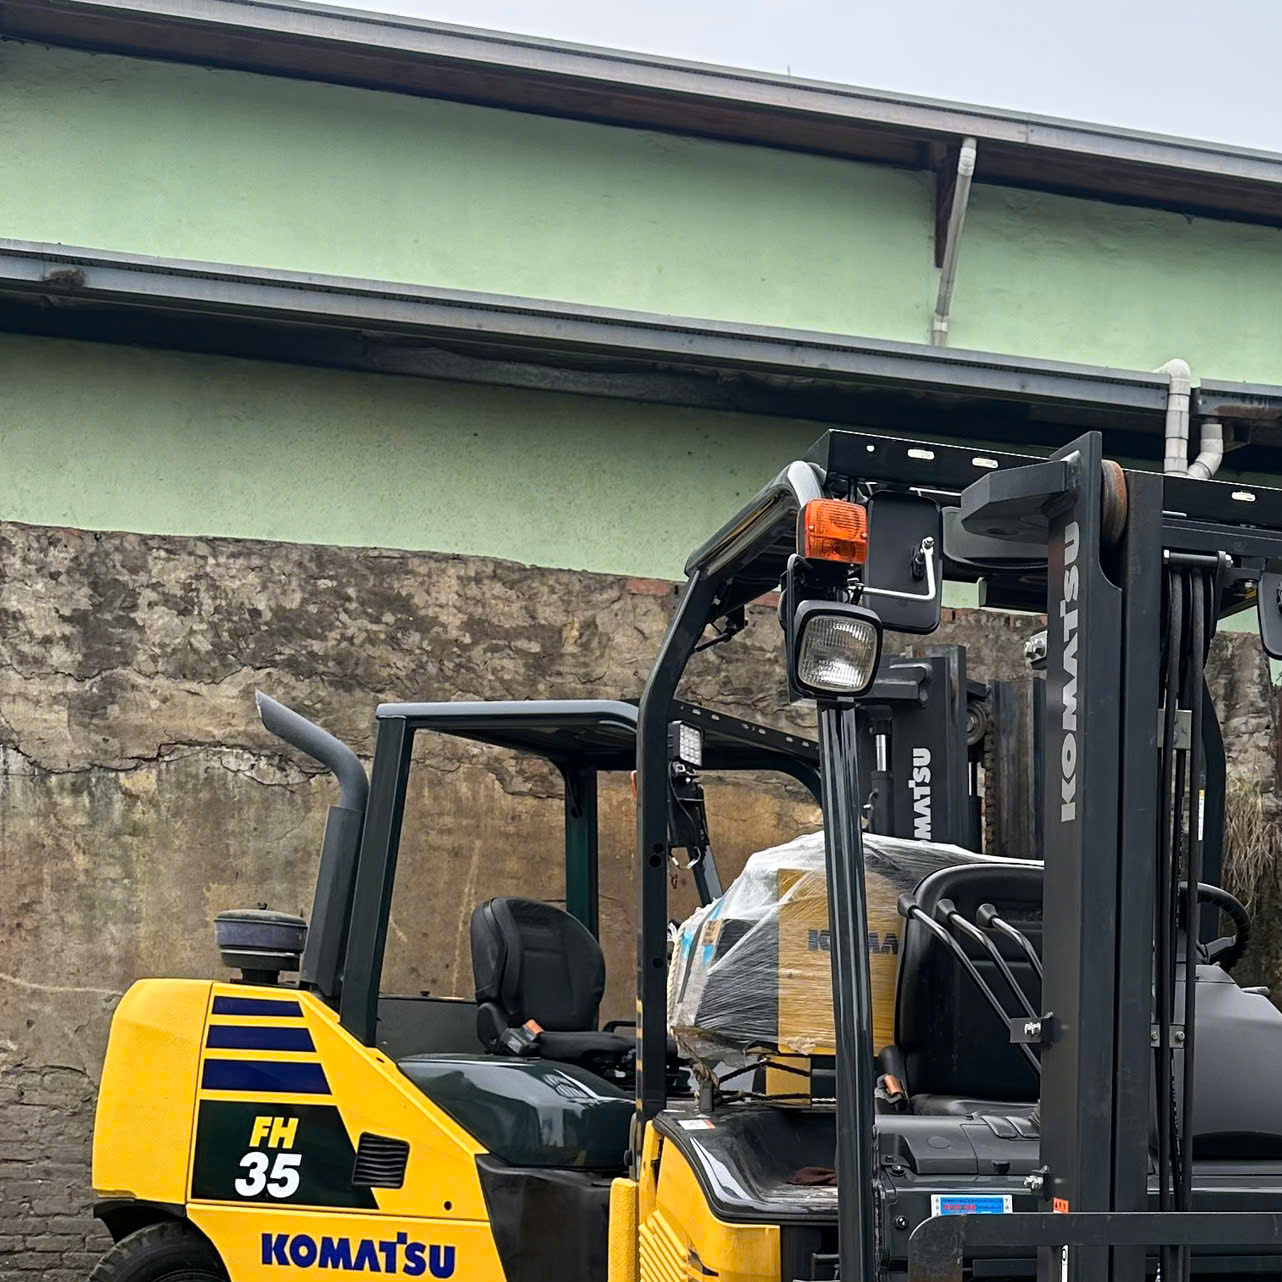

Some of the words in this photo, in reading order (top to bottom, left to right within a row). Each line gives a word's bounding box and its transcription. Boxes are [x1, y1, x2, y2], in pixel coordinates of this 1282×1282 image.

[1060, 520, 1080, 822] KOMATSU
[908, 747, 932, 840] MATSU
[249, 1116, 299, 1150] FH
[234, 1151, 302, 1199] 35
[260, 1231, 456, 1279] KOMATSU
